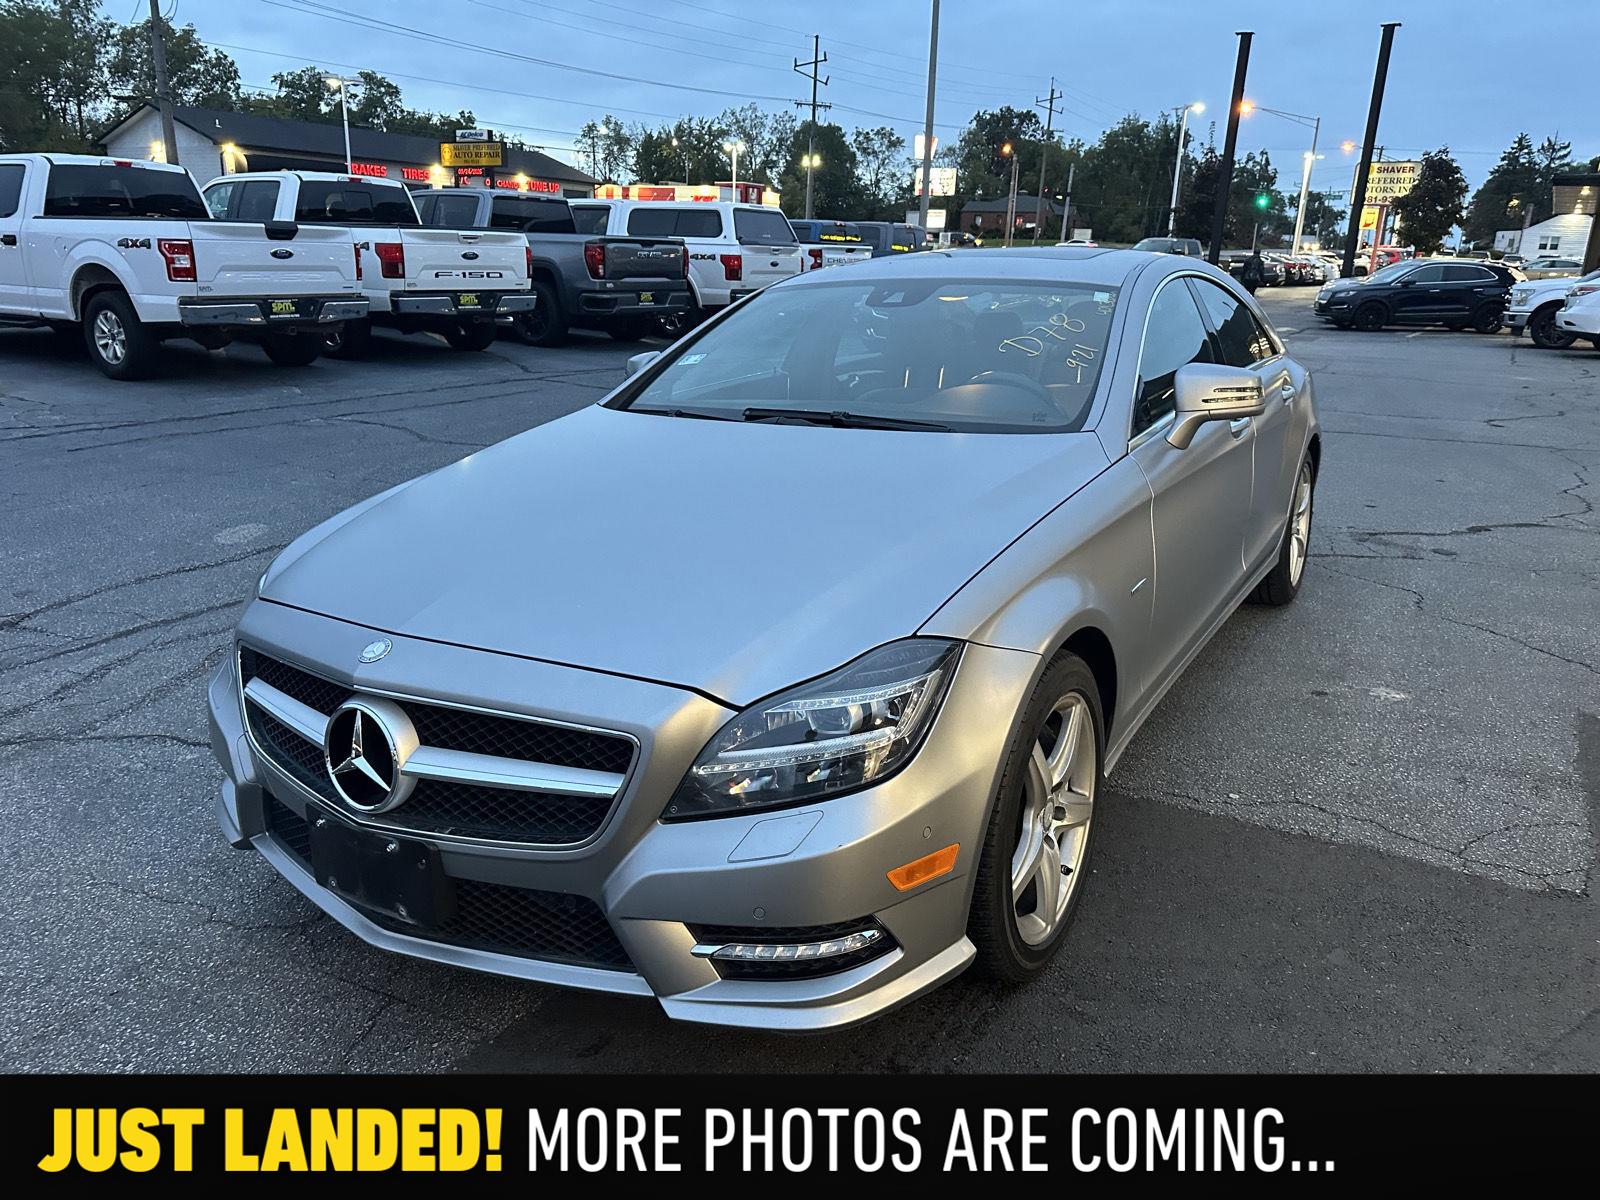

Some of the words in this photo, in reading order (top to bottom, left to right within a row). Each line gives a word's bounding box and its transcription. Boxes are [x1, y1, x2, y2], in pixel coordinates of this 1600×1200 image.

[453, 151, 473, 159] AUTO
[474, 151, 501, 159] REPAIR
[345, 162, 388, 177] RAKES
[402, 168, 430, 181] TIRES
[1376, 166, 1415, 174] SHAVER
[548, 183, 560, 193] UP
[999, 313, 1085, 356] D78
